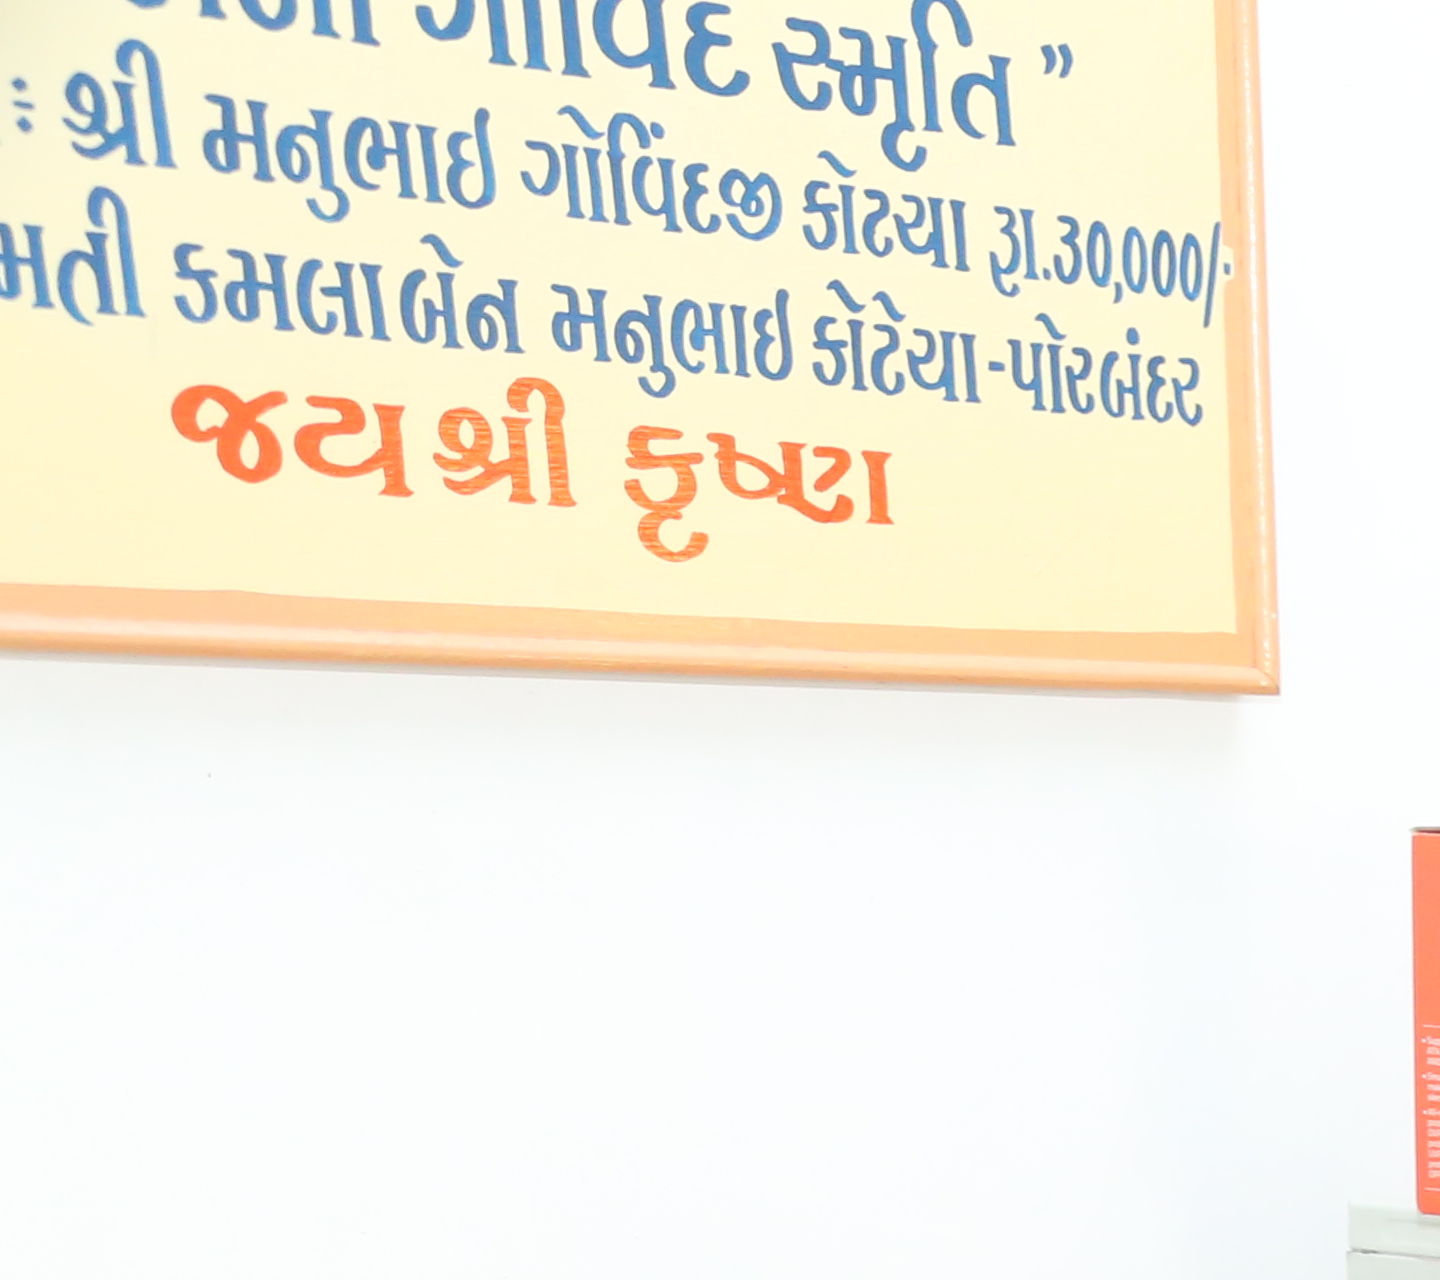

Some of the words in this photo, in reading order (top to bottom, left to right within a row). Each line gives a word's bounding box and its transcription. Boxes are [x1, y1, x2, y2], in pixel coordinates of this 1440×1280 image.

[62, 38, 178, 170] શ્રી
[172, 383, 414, 498] જય
[433, 377, 578, 508] શ્રી
[624, 425, 895, 563] કૃષ્ણ
